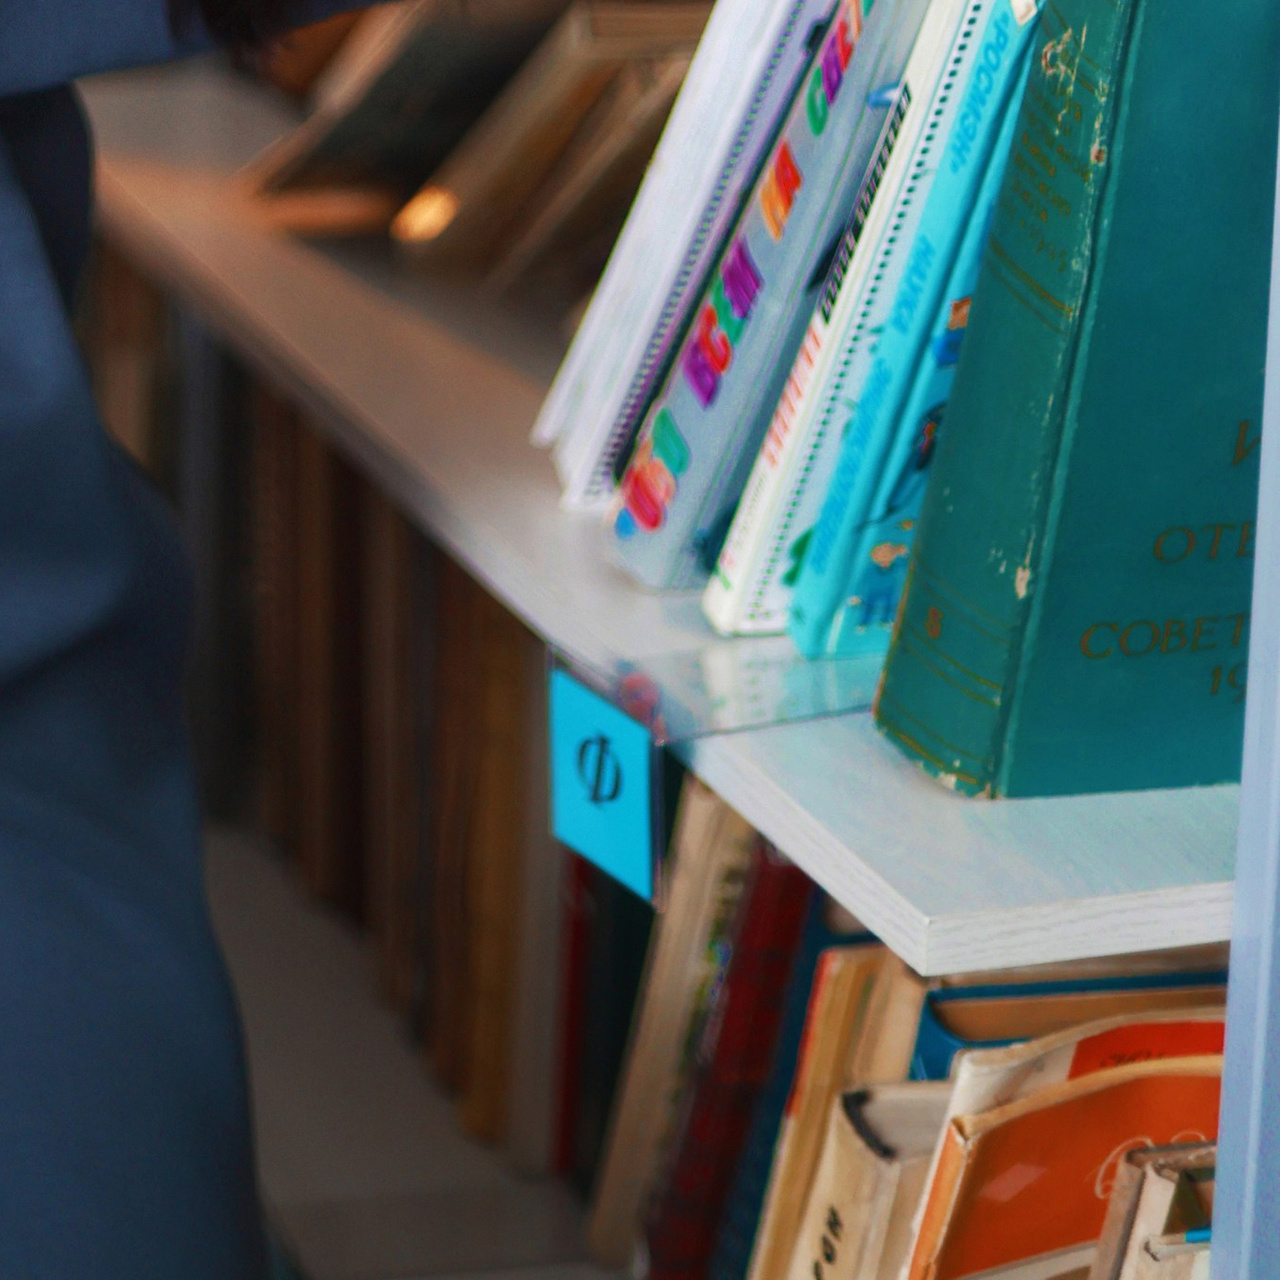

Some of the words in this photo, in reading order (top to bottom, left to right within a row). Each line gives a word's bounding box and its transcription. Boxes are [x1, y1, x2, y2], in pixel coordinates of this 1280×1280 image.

[759, 142, 803, 241] НА
[1079, 612, 1252, 659] СОВЕТ
[577, 733, 623, 805] Ф
